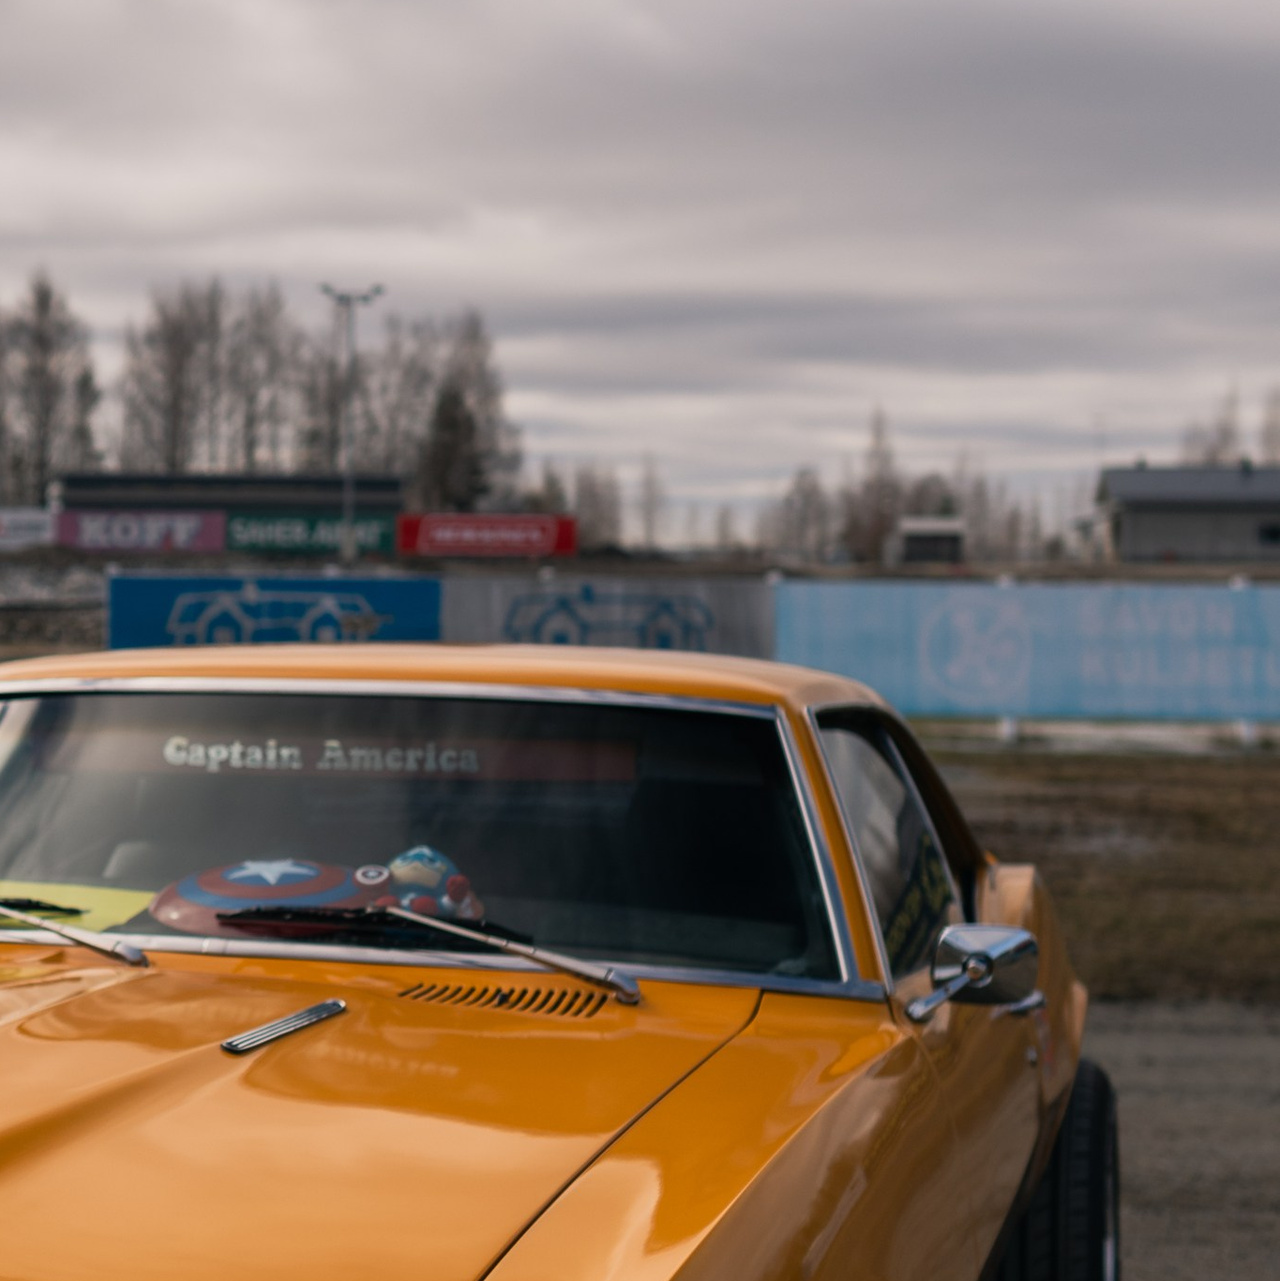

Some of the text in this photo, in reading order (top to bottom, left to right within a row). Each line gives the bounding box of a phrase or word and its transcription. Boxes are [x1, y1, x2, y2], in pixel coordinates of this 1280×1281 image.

[76, 511, 202, 550] KOFF
[163, 735, 480, 773] Captain America
